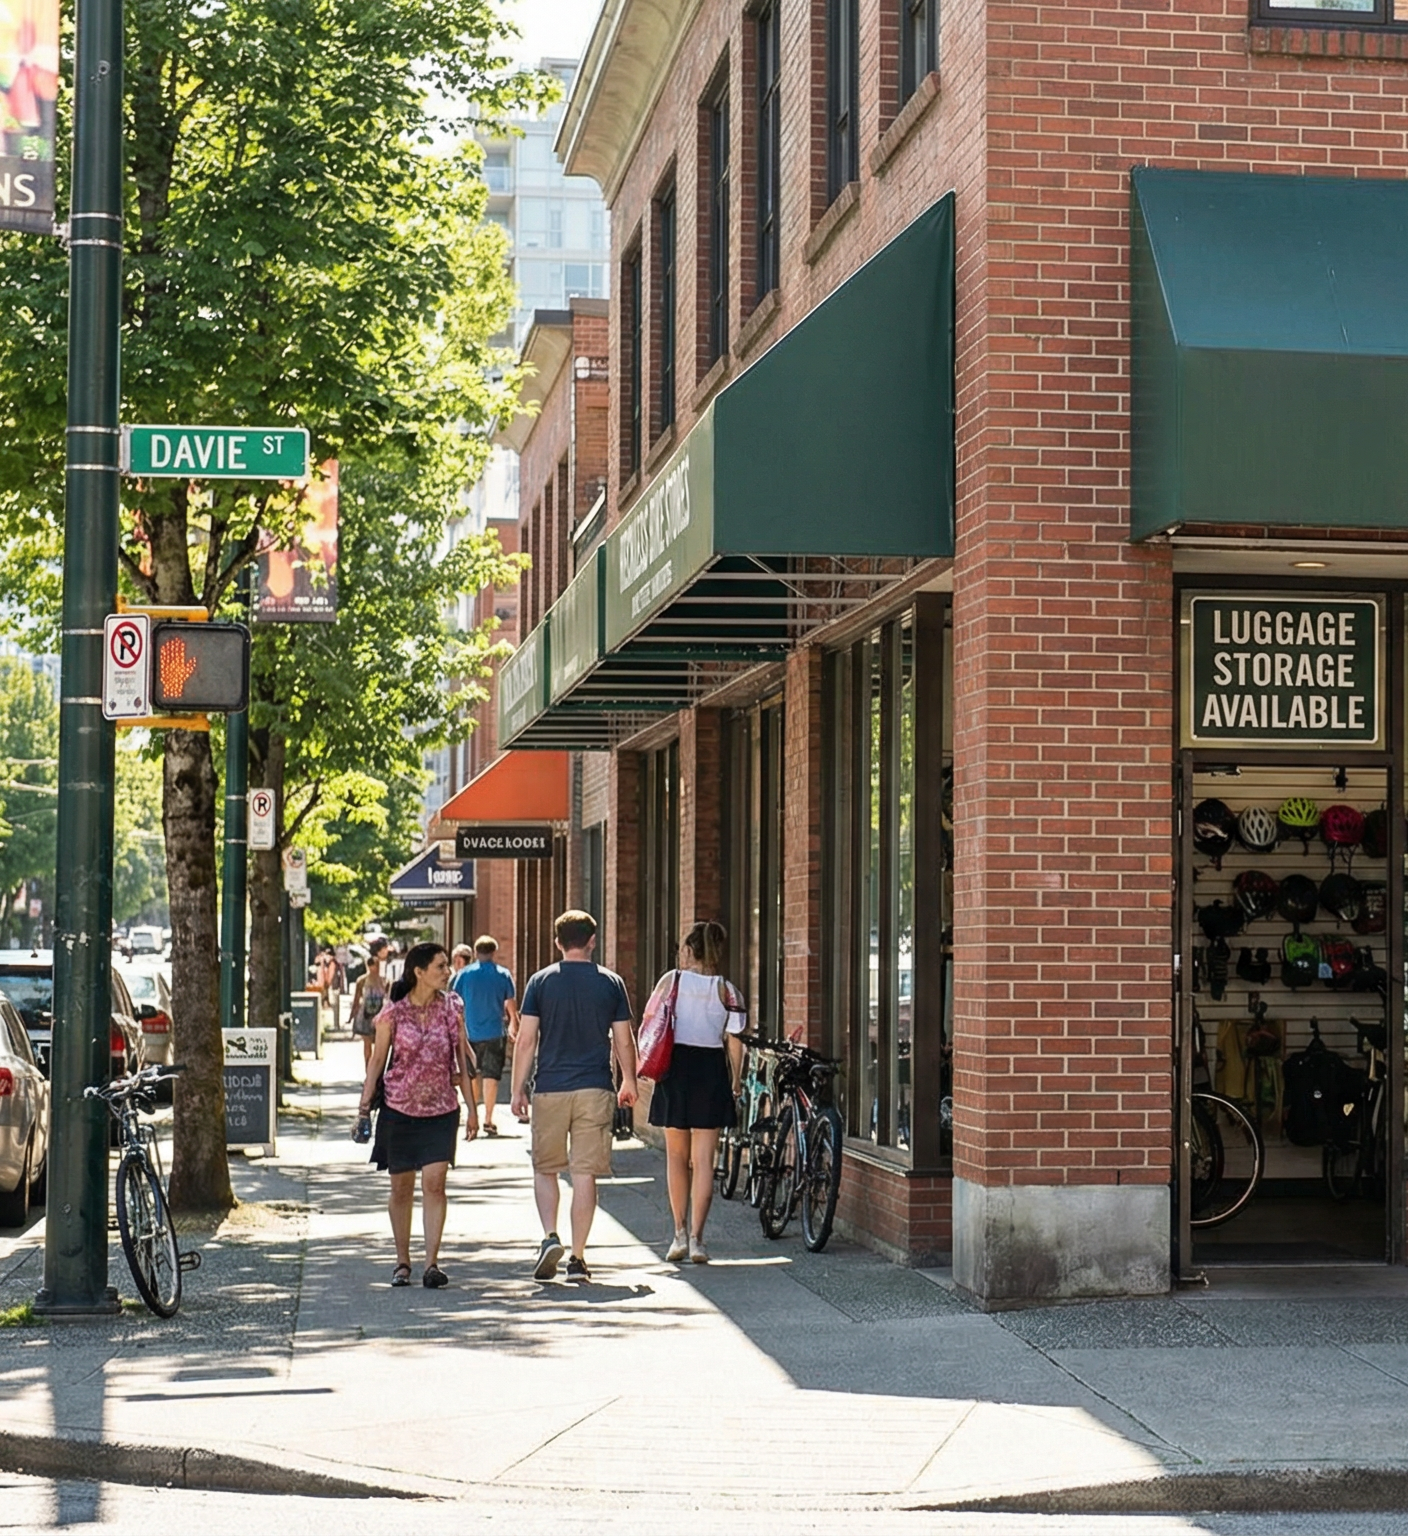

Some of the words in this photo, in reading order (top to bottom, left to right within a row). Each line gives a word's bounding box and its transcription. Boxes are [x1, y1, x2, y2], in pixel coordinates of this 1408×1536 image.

[150, 434, 247, 470] DAVIE
[262, 435, 285, 455] ST
[1213, 609, 1356, 646] LUGGAGE
[1213, 651, 1355, 688] STORAGE
[1202, 693, 1366, 729] AVAILABLE
